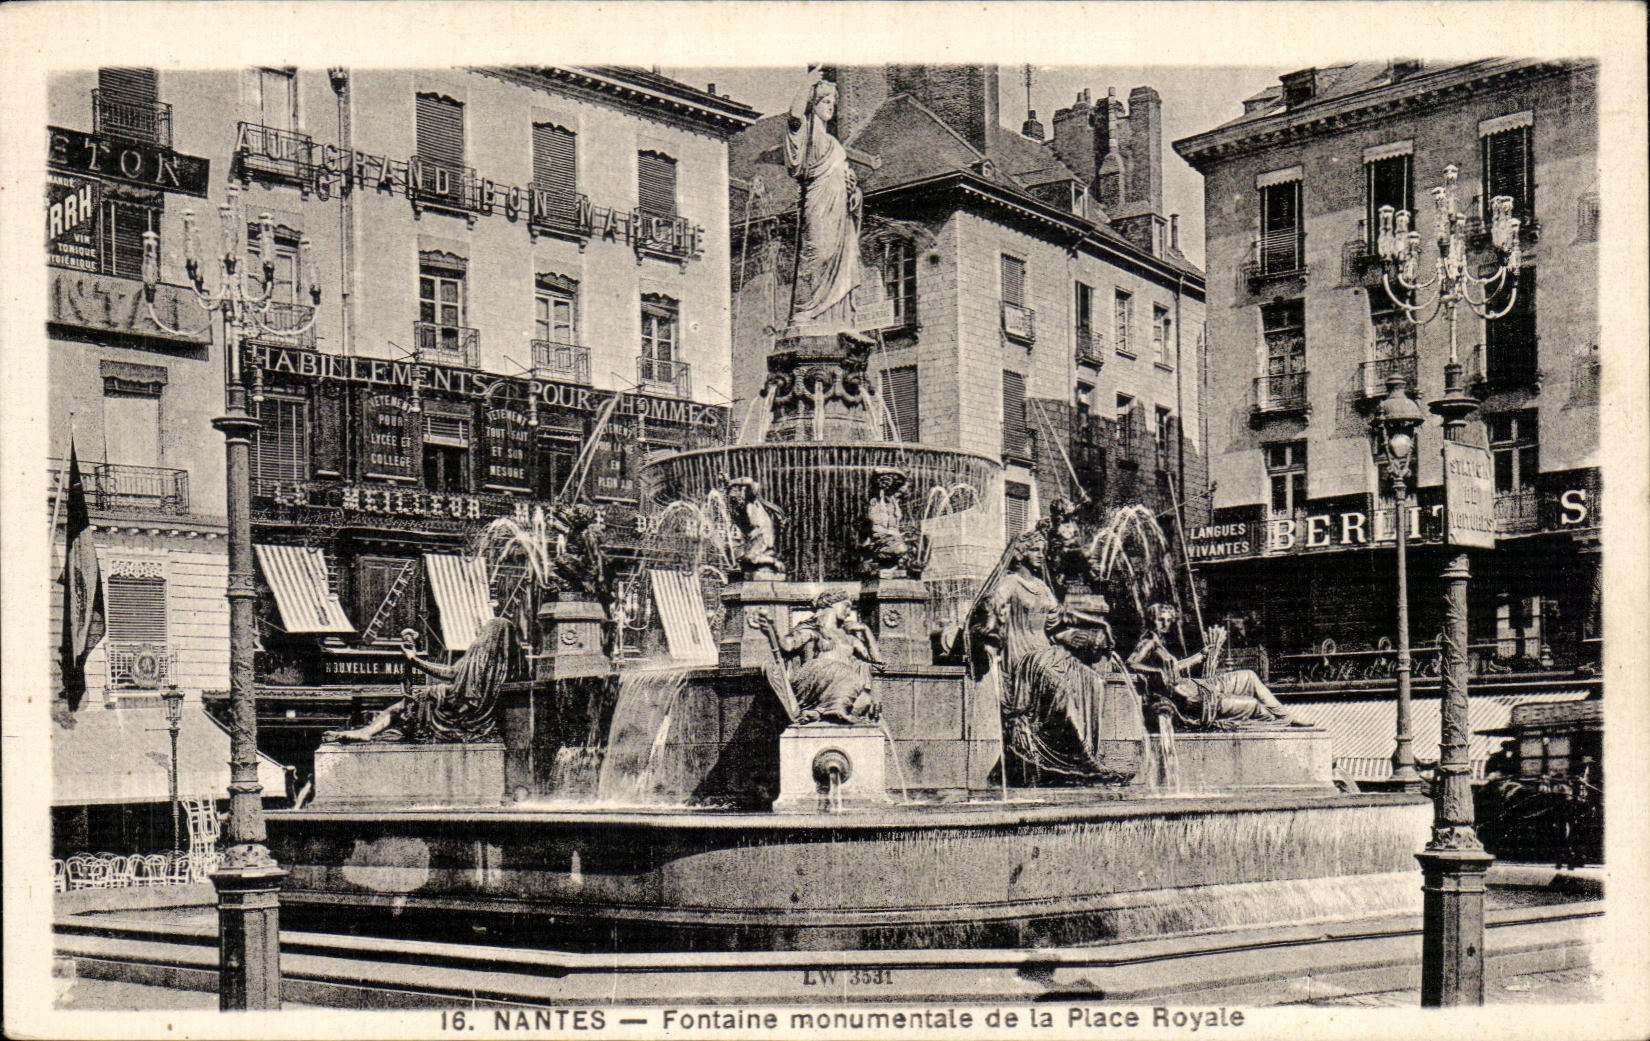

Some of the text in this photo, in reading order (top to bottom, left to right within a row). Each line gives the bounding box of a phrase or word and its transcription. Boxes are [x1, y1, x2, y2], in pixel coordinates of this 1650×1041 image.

[323, 142, 450, 196] GRAND
[481, 177, 547, 218] BON
[74, 233, 91, 244] VIN
[57, 242, 97, 258] TONIQUE
[253, 344, 719, 428] HABILLEMENTS POUR HOMMES
[371, 432, 411, 448] LYCÉE ET
[342, 487, 480, 520] MEILLEUR
[1190, 523, 1246, 540] LANGUES
[1187, 541, 1250, 557] VIVANTES
[325, 662, 379, 674] NOUVELLE
